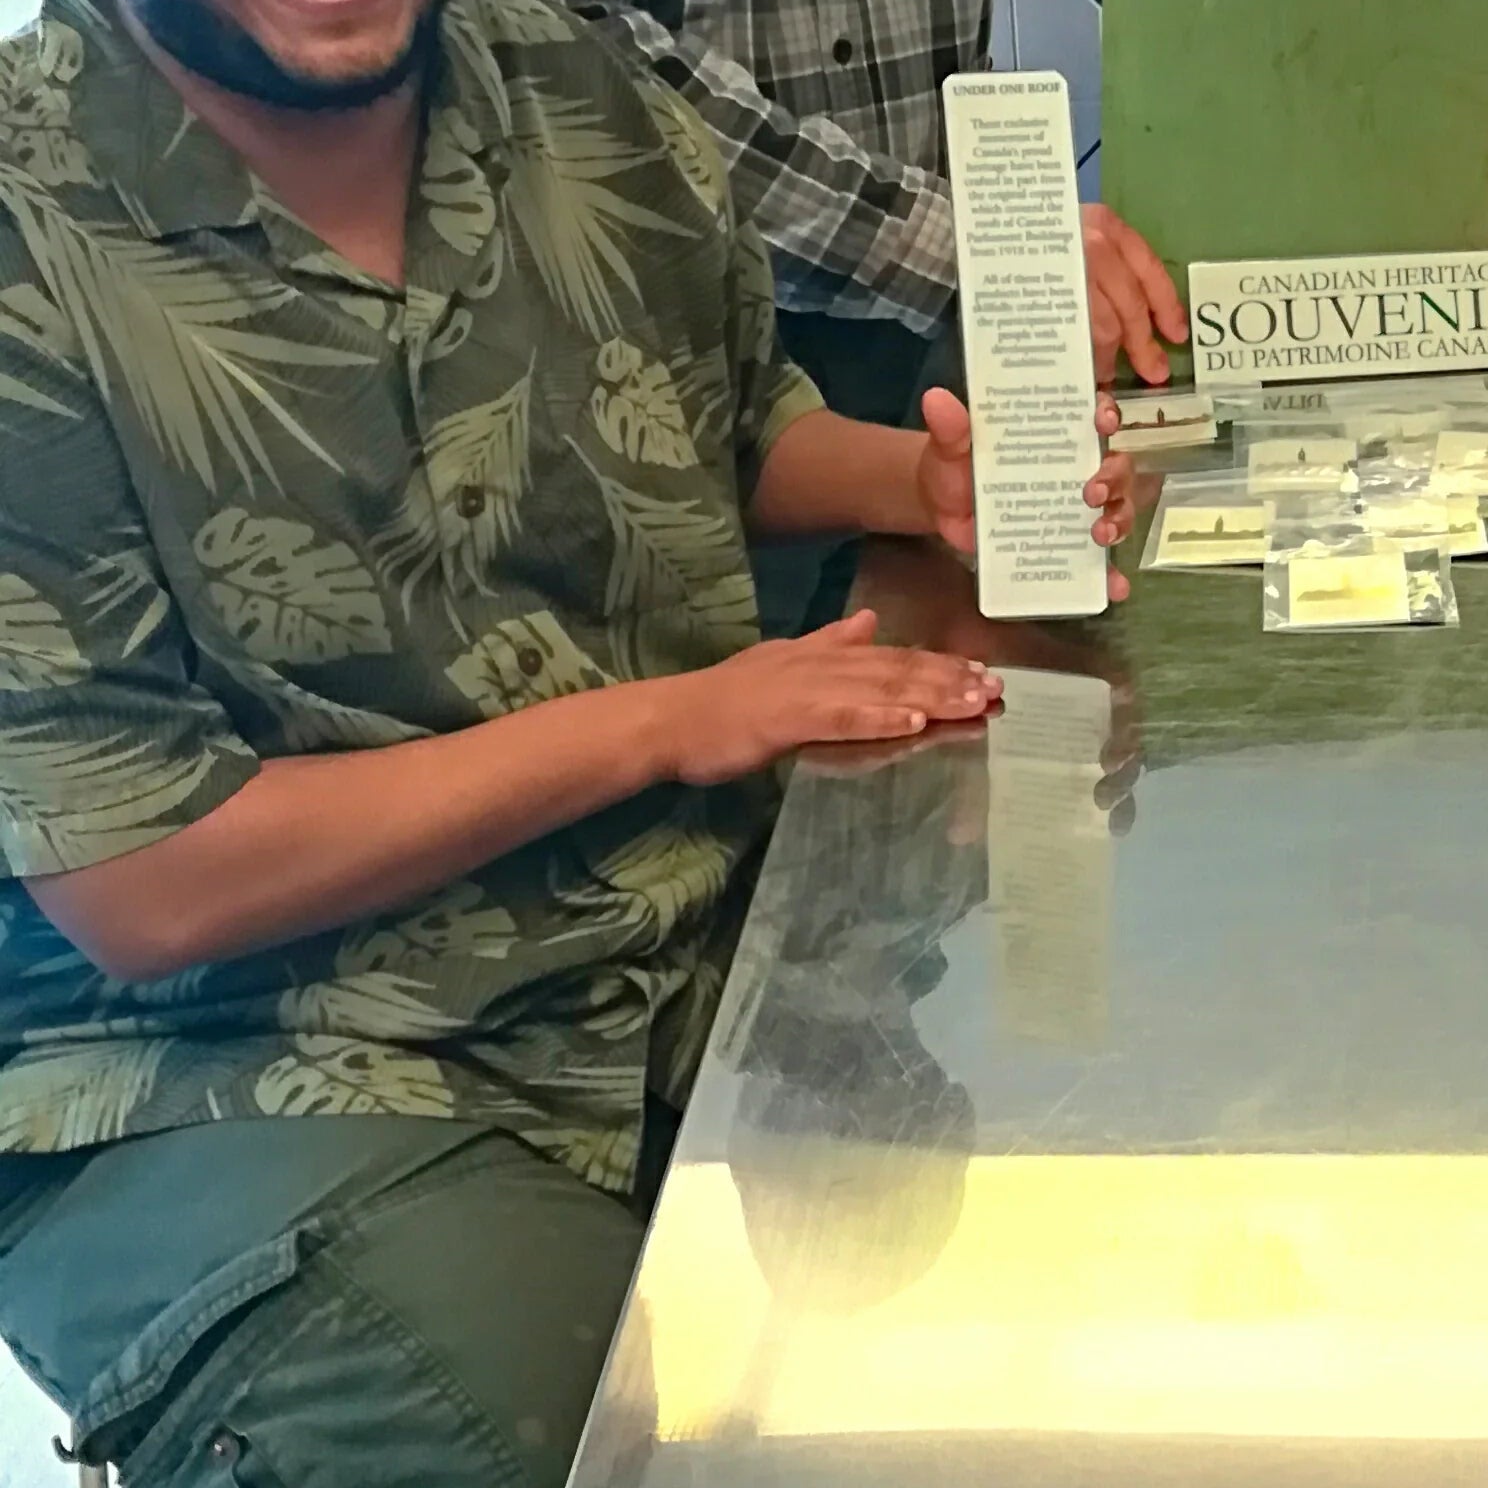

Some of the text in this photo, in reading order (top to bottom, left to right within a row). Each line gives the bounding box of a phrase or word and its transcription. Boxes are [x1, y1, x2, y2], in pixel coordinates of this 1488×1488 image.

[953, 82, 1061, 96] UNDER ONE ROOF
[1239, 269, 1376, 294] CANADIAN
[1206, 350, 1243, 370] DU
[1252, 342, 1410, 368] PATRIMOINE
